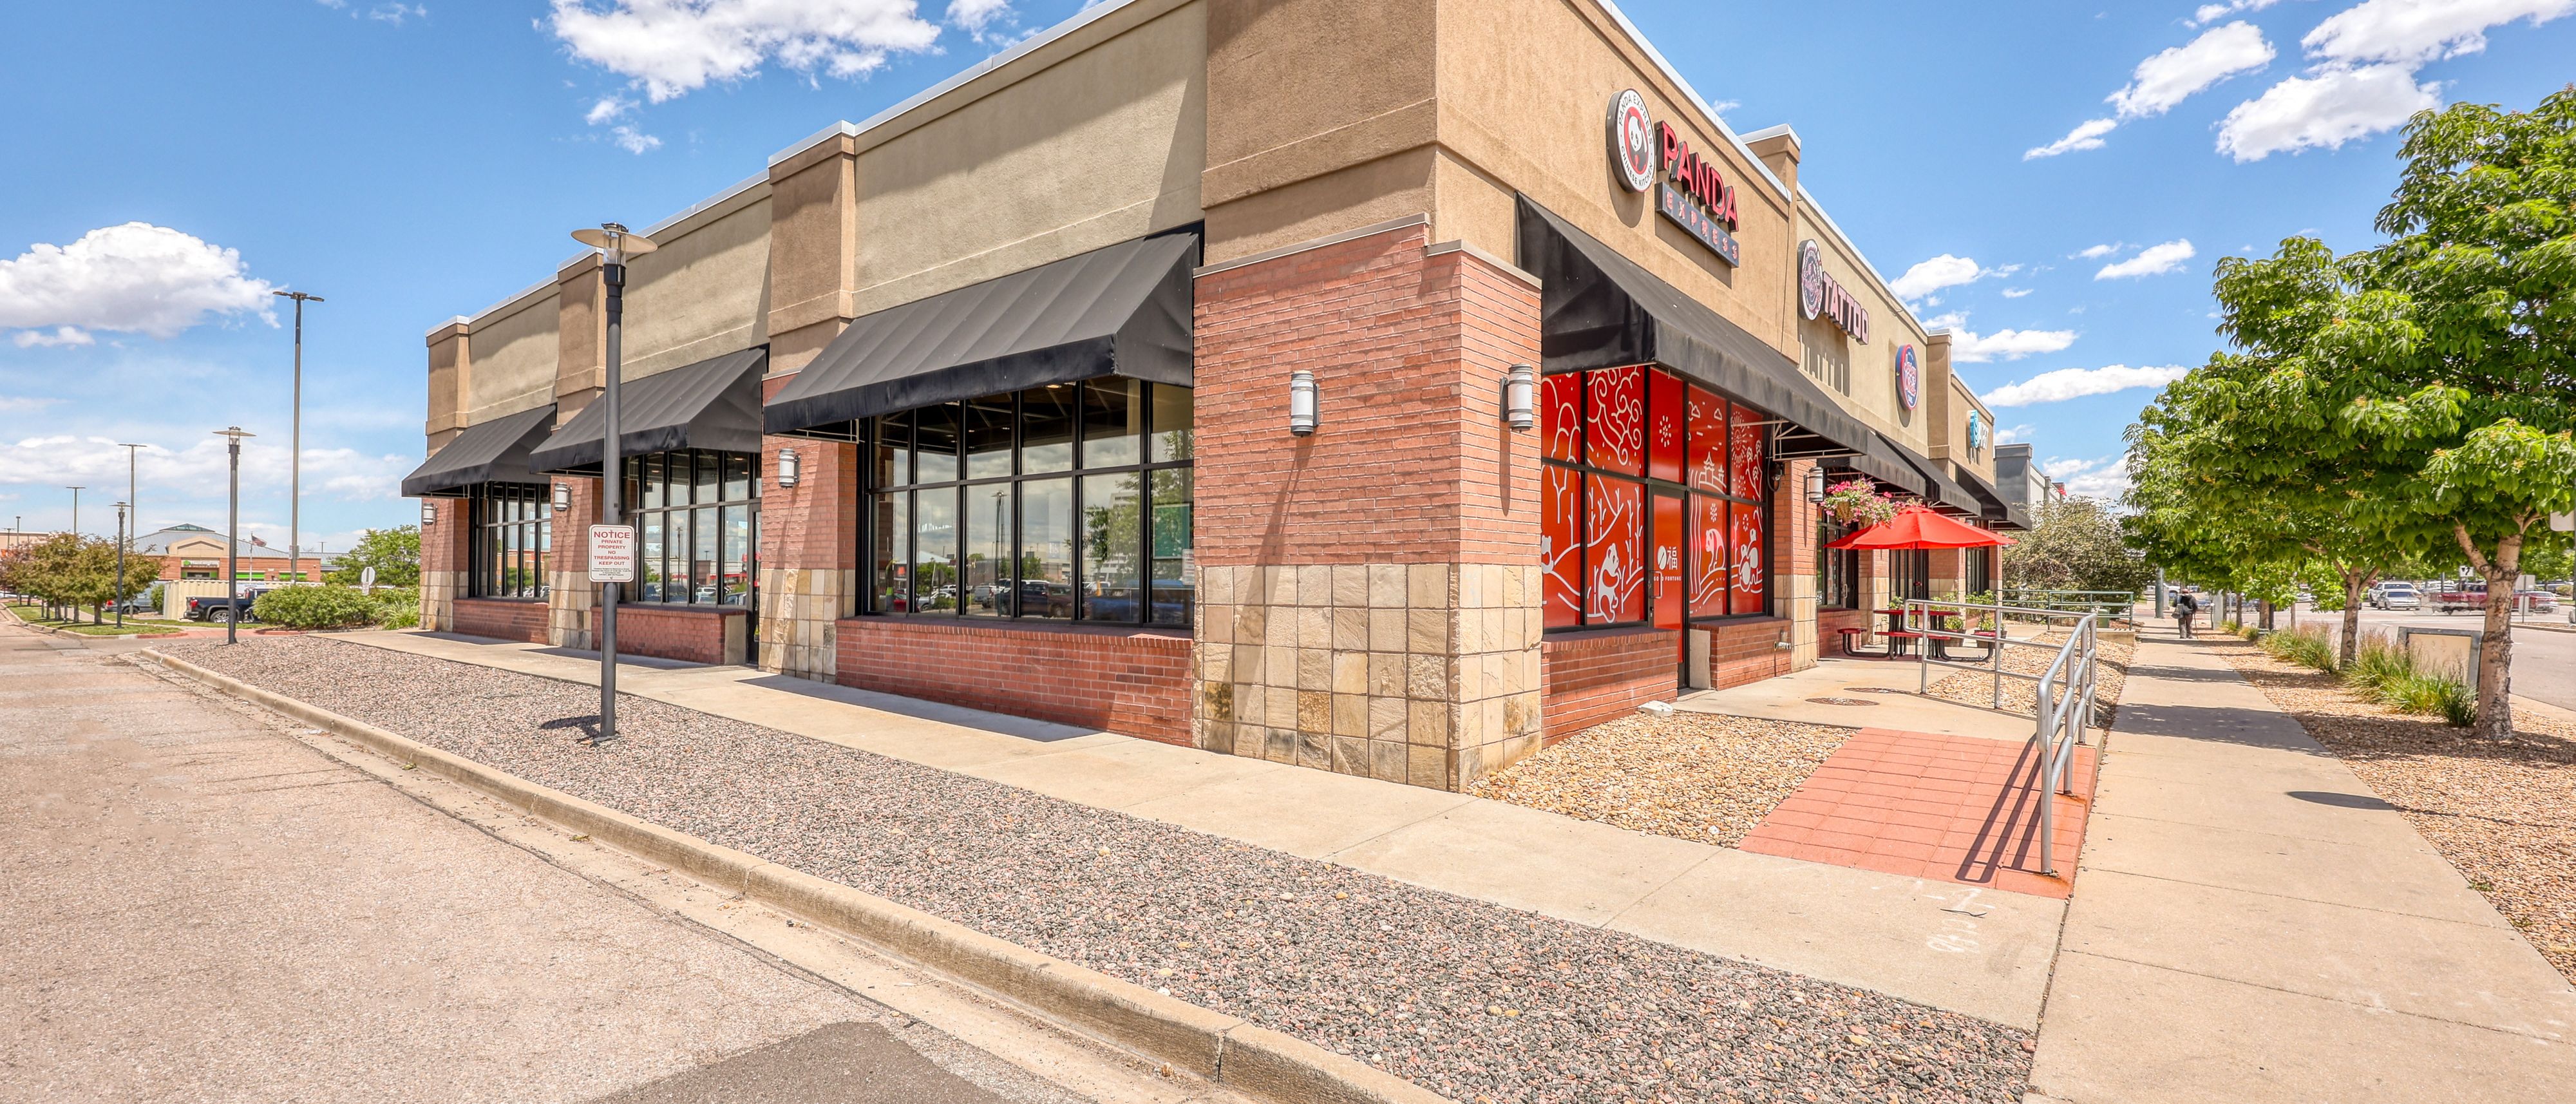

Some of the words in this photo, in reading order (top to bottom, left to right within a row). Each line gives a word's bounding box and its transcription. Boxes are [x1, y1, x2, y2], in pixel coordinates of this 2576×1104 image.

[1618, 94, 1632, 126] PANDA
[1633, 95, 1653, 144] EXPRESS
[1621, 146, 1638, 185] CHINESE
[1639, 162, 1653, 186] KITCHEN
[1662, 120, 1739, 232] PANDA
[1666, 191, 1738, 260] EXPRESS
[1823, 271, 1869, 345] TATTOO
[594, 530, 630, 538] NOTICE
[1667, 546, 1678, 570] 福
